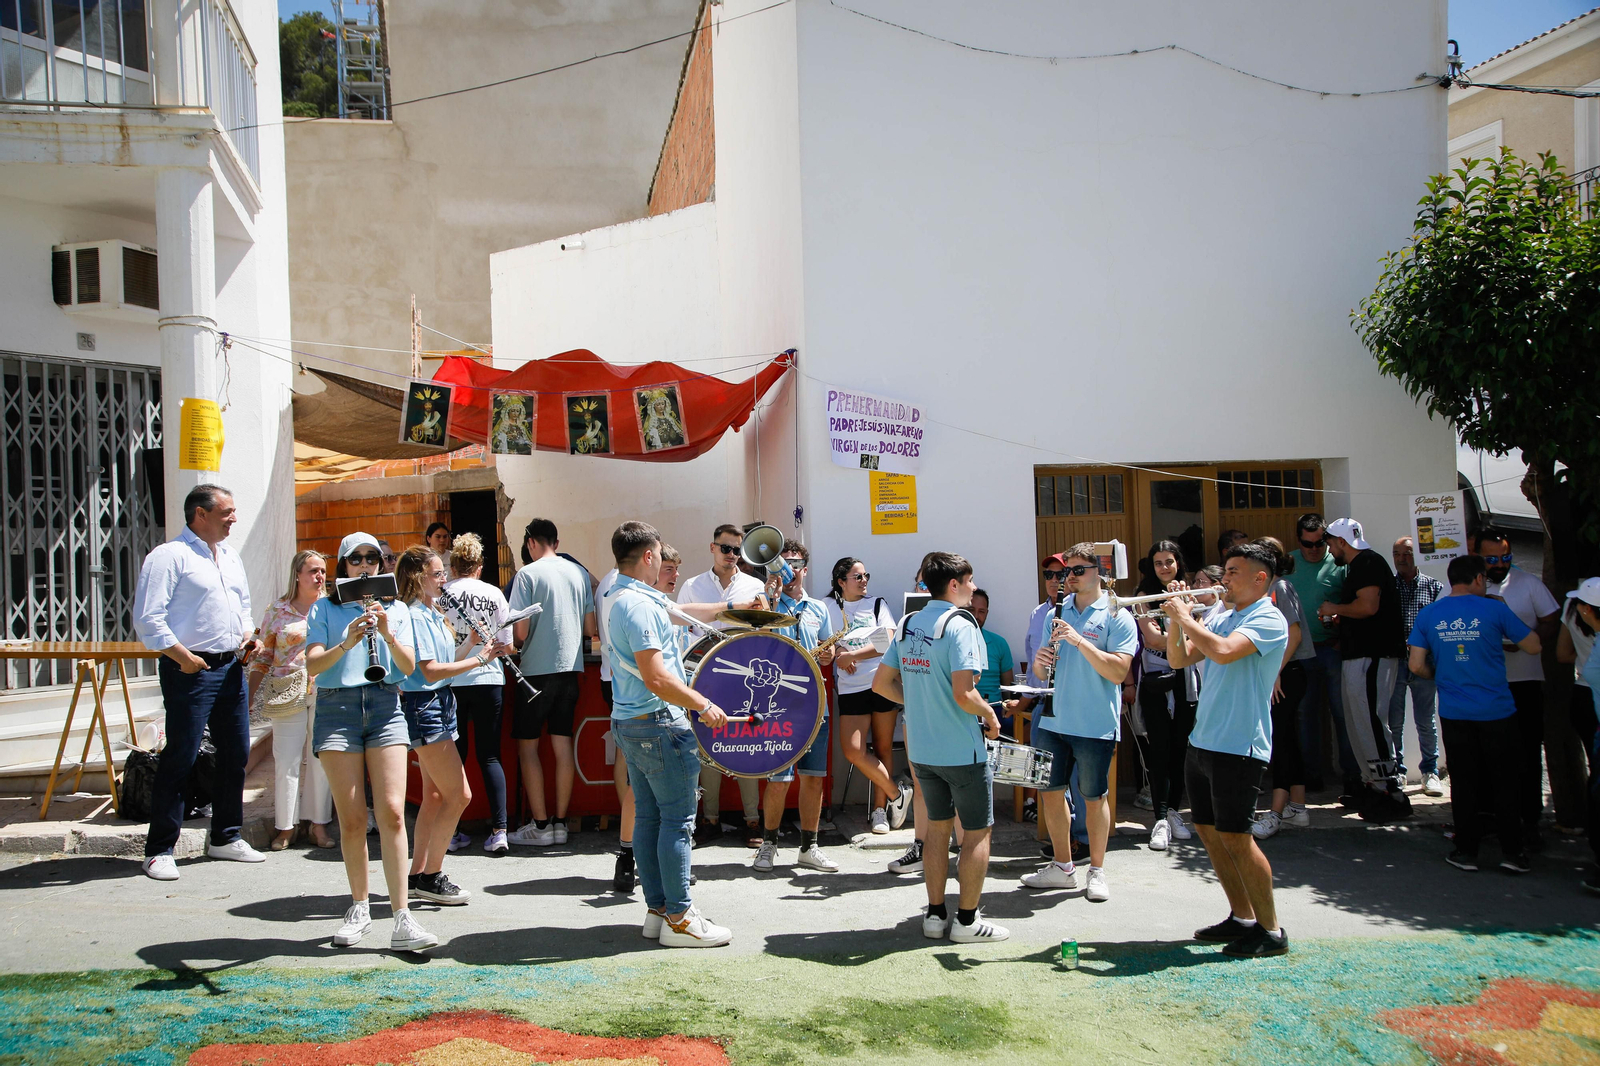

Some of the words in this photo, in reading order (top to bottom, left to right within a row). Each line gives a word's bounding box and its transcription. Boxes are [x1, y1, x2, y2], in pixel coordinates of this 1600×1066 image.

[827, 390, 920, 423] PREHERMANDAD
[830, 438, 859, 453] VIRGEN
[860, 443, 868, 451] DE
[868, 443, 878, 452] LOS
[879, 440, 920, 458] DOLORES
[902, 657, 931, 668] PIJAMAS
[712, 721, 793, 739] PIJAMAS
[712, 741, 763, 756] Charanga
